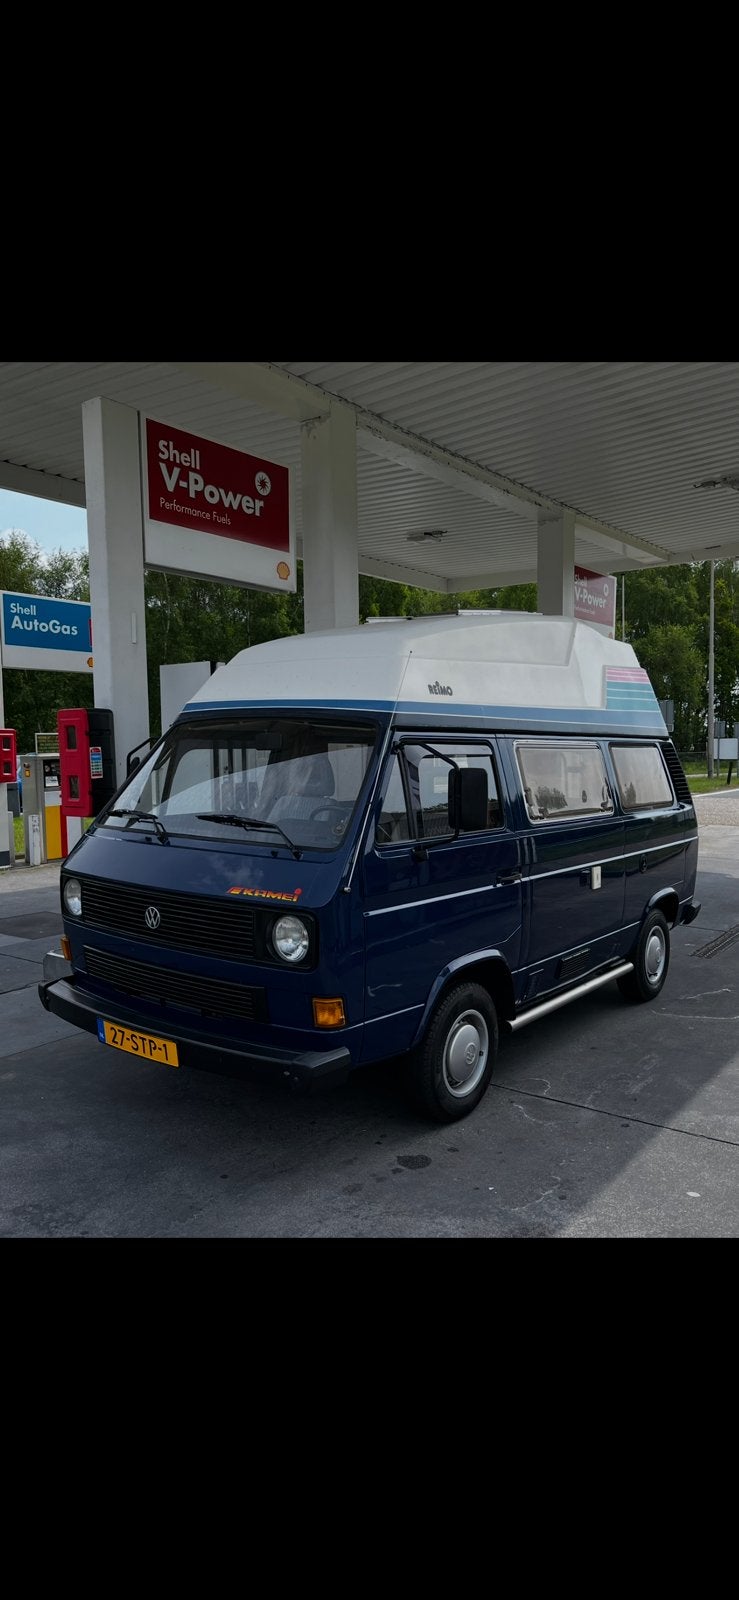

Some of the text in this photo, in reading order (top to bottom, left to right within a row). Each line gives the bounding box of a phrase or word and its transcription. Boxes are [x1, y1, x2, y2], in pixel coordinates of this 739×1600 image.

[158, 439, 200, 470] Shell
[159, 461, 264, 517] V-Power
[160, 497, 231, 525] Performance Fuels
[10, 602, 37, 616] Shell
[574, 586, 607, 608] V-Power
[11, 615, 78, 636] AutoGas
[110, 1026, 169, 1061] 27-STP-1
